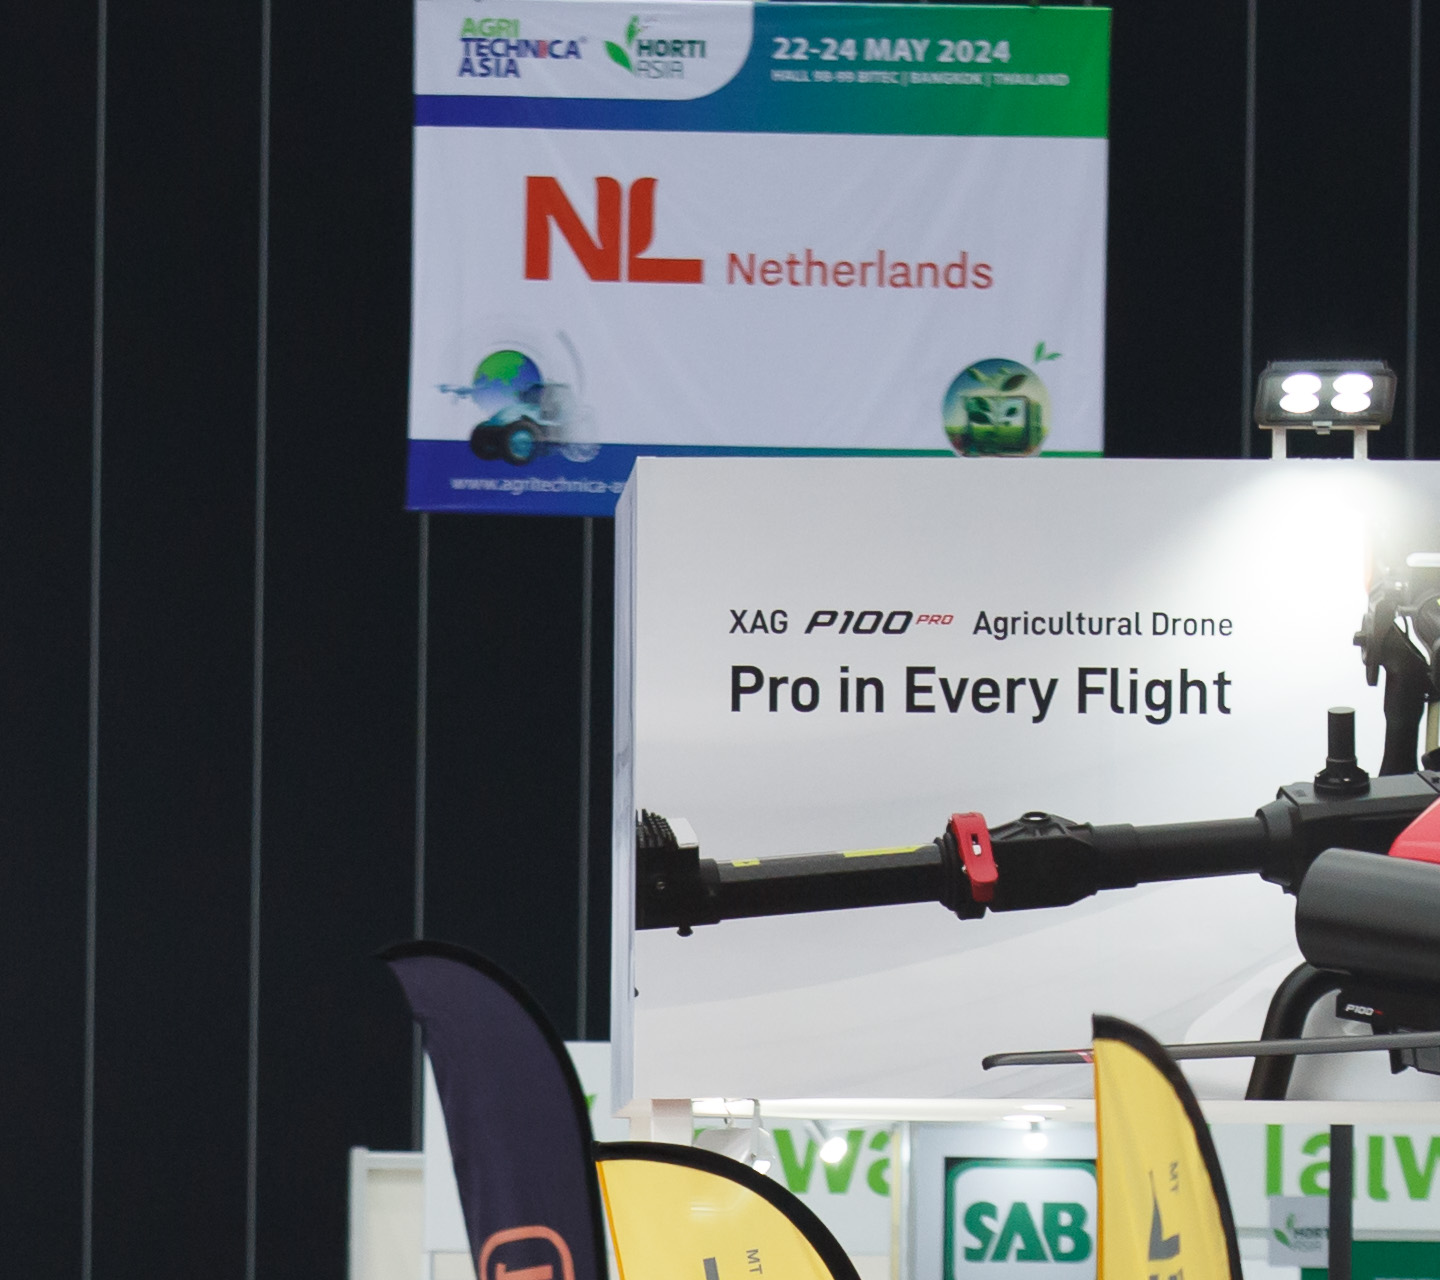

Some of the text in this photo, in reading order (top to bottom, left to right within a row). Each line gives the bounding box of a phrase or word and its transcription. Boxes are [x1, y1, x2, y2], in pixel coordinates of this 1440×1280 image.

[461, 18, 520, 37] AGRI
[636, 40, 706, 58] HORTI
[772, 37, 1011, 63] 22-24 MAY 2024
[458, 57, 520, 78] ASIA
[524, 175, 704, 284] NL
[727, 248, 994, 290] Netherlands
[728, 609, 788, 635] XAG
[805, 610, 913, 635] P100
[973, 611, 1143, 641] Agricultural
[1151, 611, 1234, 637] Drone
[729, 665, 1234, 726] Pro in Every Flight
[963, 1200, 1092, 1263] SAB
